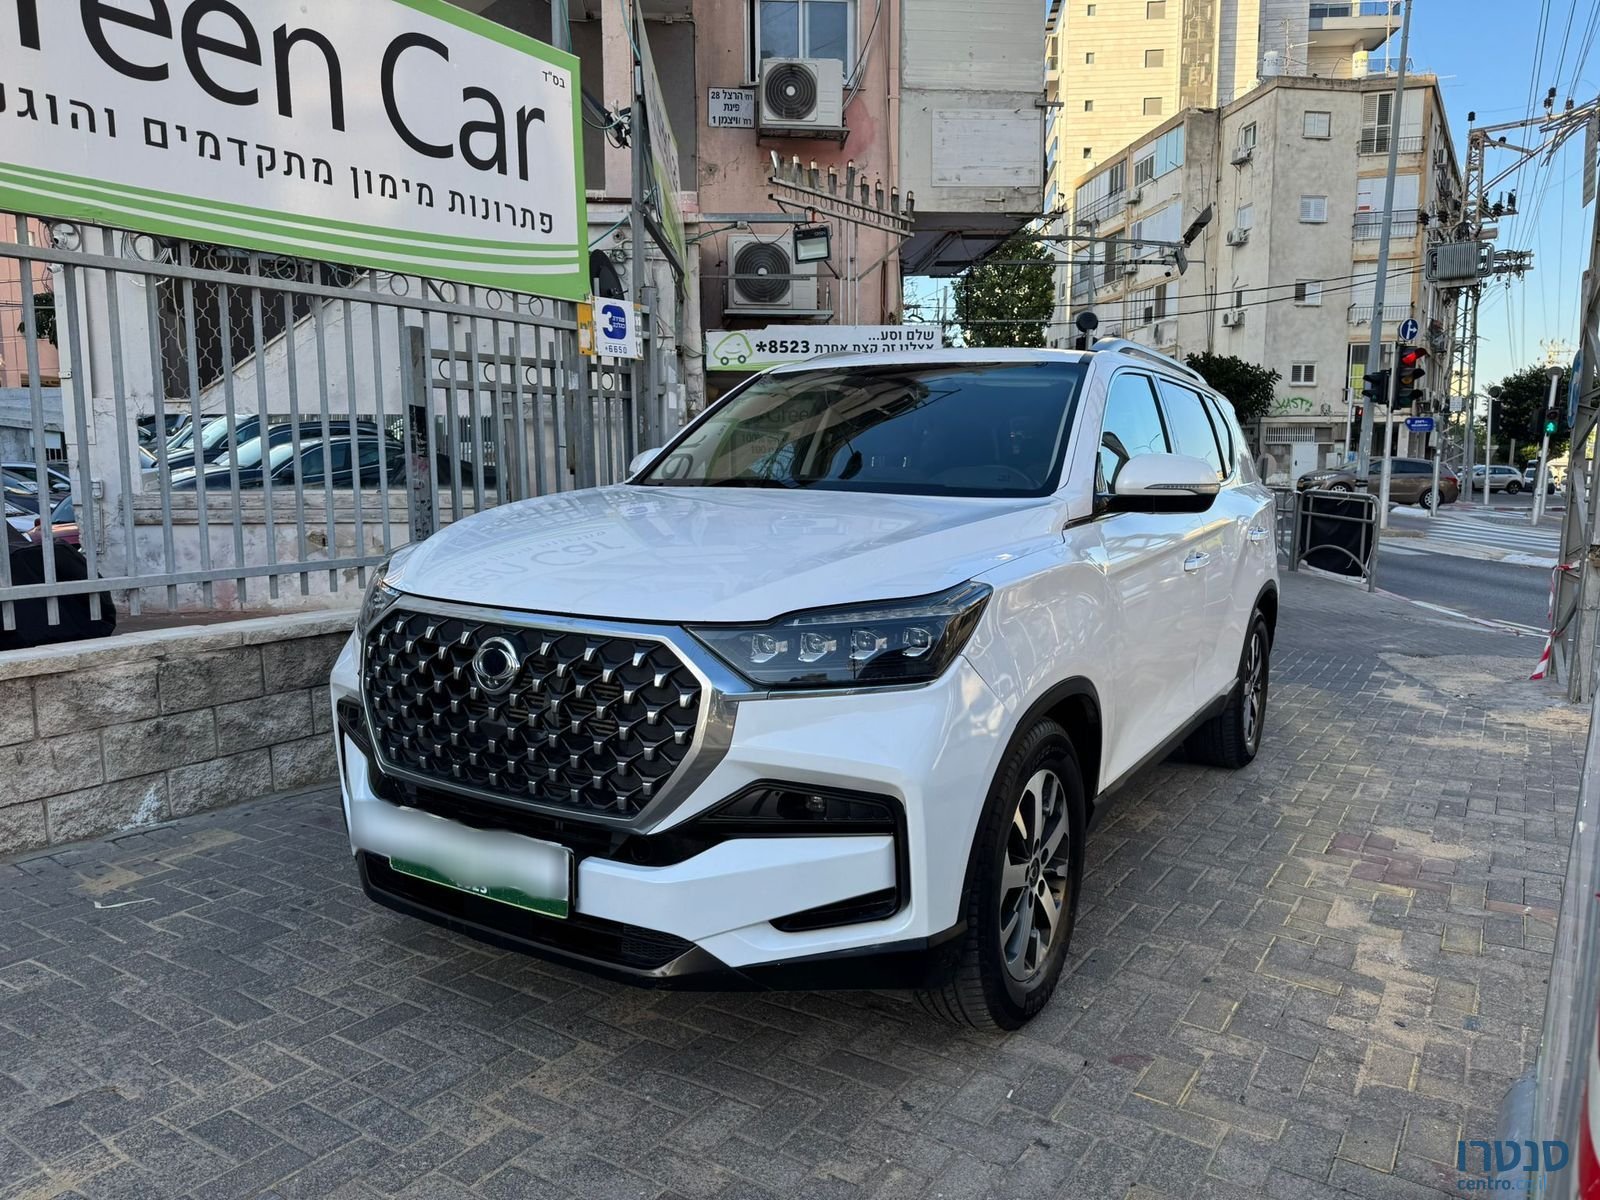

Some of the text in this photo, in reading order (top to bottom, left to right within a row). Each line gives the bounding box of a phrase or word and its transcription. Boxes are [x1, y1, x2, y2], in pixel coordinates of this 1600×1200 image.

[541, 70, 566, 89] בס"ד
[711, 91, 720, 100] 28
[722, 89, 743, 100] הרצל
[381, 32, 545, 181] Car
[723, 103, 740, 112] פינת
[712, 116, 716, 124] 1
[143, 117, 334, 186] מתקדמים
[350, 166, 434, 208] מימון
[448, 190, 554, 234] פתרונות
[906, 329, 935, 341] שלם
[814, 343, 848, 354] אחרת
[882, 343, 896, 352] זה
